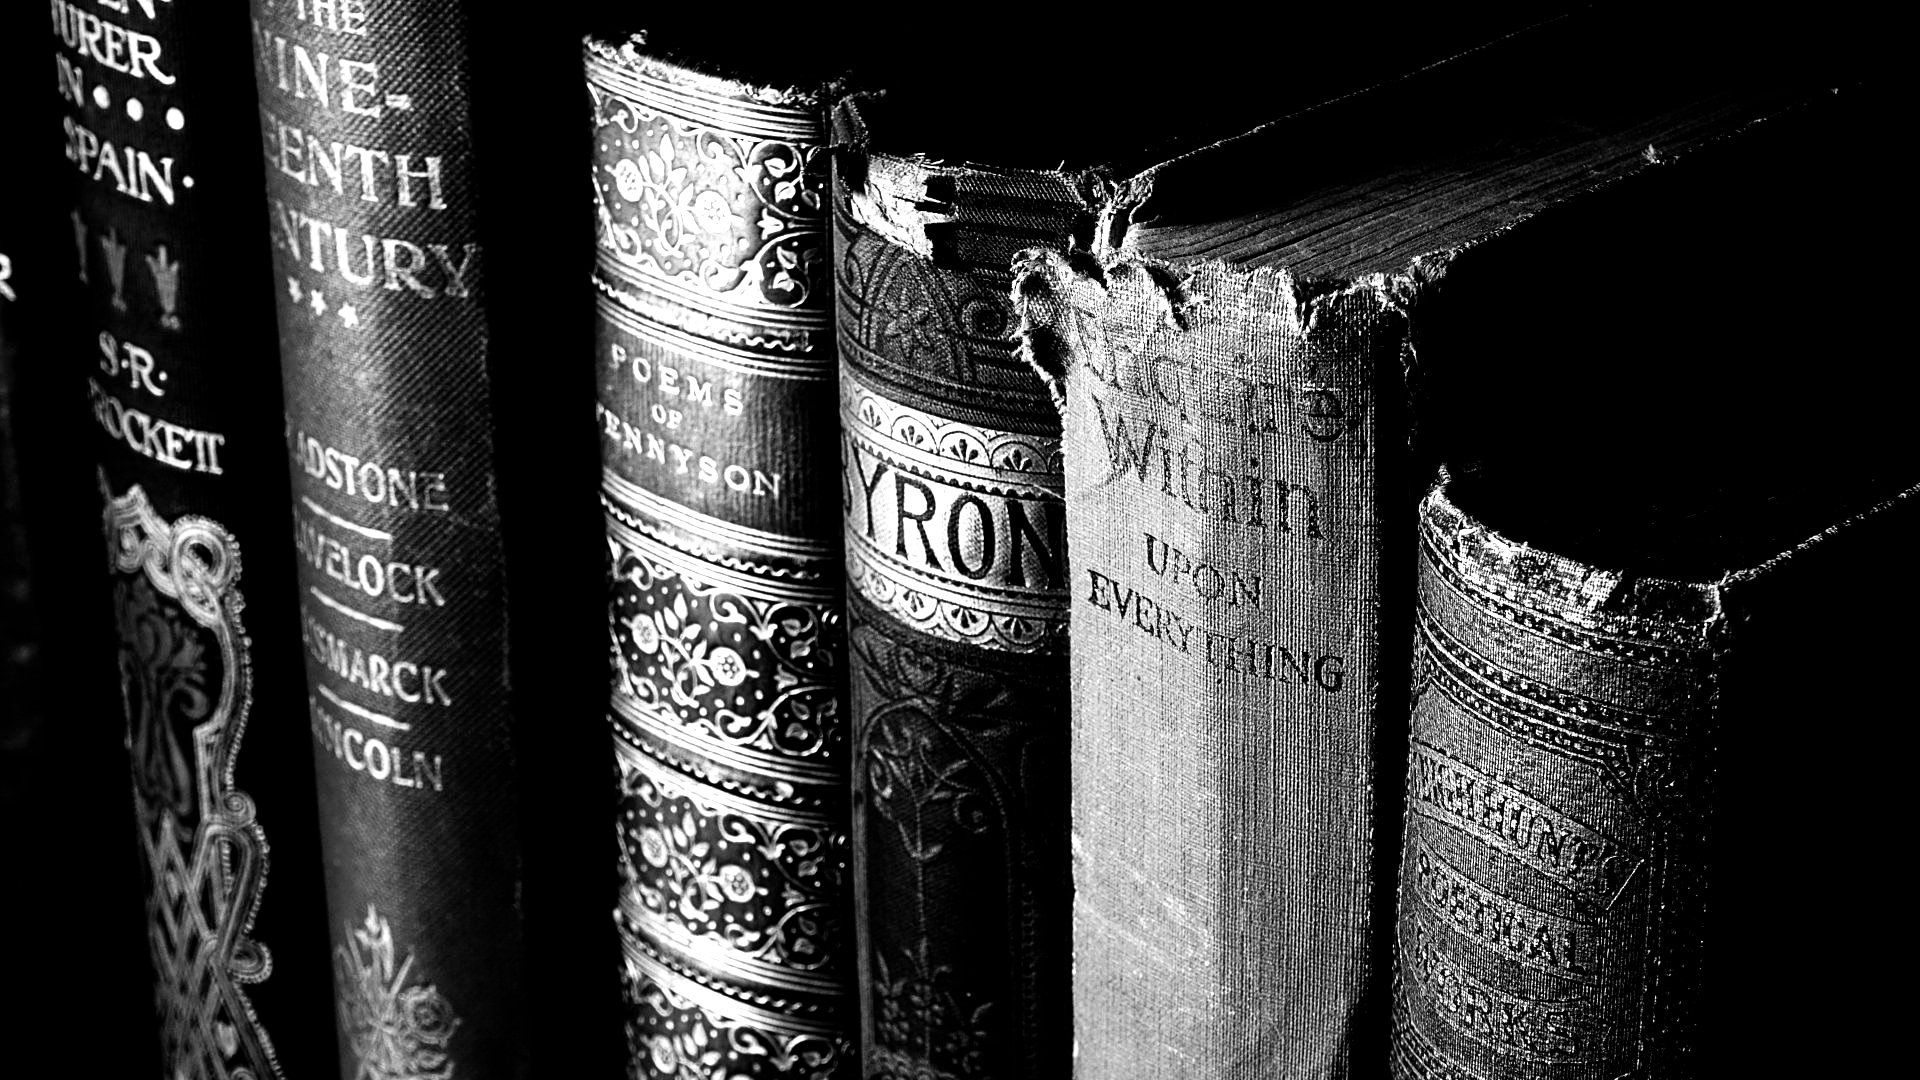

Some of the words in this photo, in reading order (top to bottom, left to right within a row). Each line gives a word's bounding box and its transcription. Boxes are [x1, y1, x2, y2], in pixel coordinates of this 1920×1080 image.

[611, 343, 743, 416] POEMS
[651, 403, 683, 429] OF
[1091, 394, 1332, 542] Within
[1143, 531, 1262, 610] UPON
[1087, 568, 1345, 693] EVERYTHING
